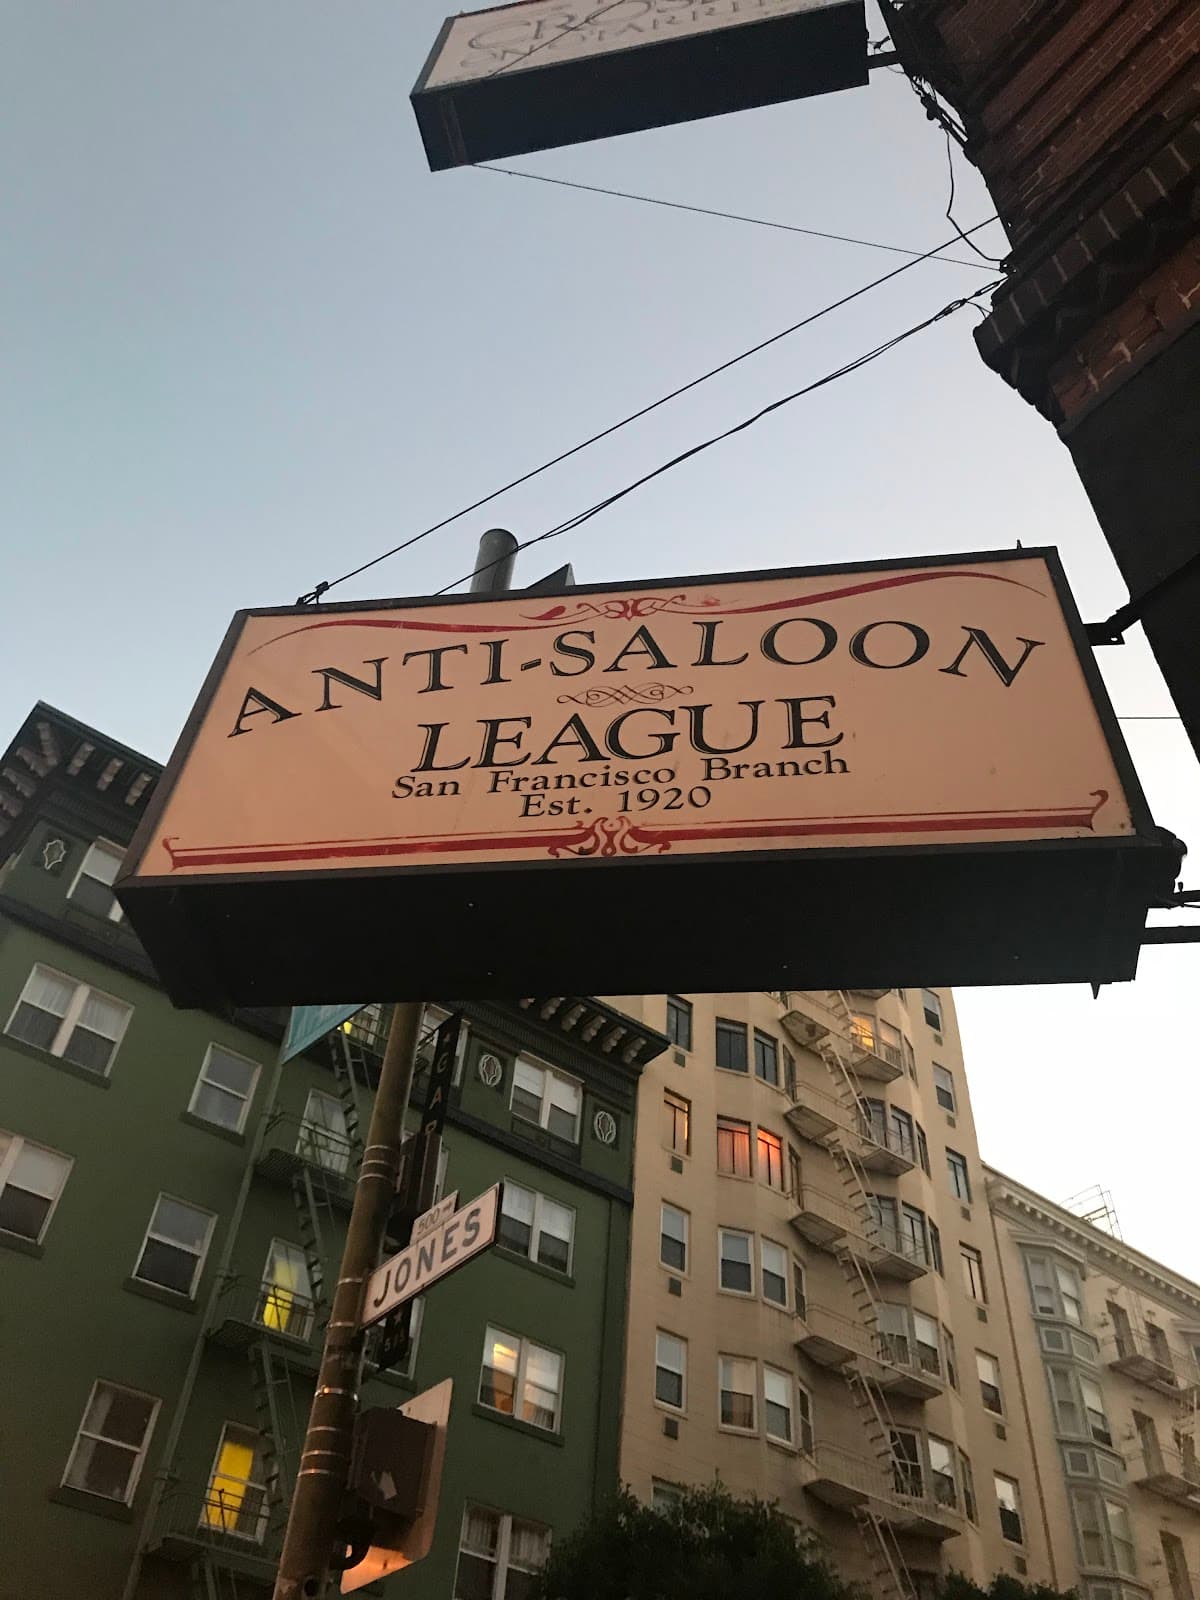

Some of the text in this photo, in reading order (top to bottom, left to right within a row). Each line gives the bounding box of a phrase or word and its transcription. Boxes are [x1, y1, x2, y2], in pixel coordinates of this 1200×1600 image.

[227, 617, 1046, 738] ANTI-SALOON
[410, 695, 844, 772] LEAGUE
[391, 750, 851, 799] San Francisco Branch
[518, 785, 712, 819] Est. 1920
[373, 1207, 482, 1308] JONES
